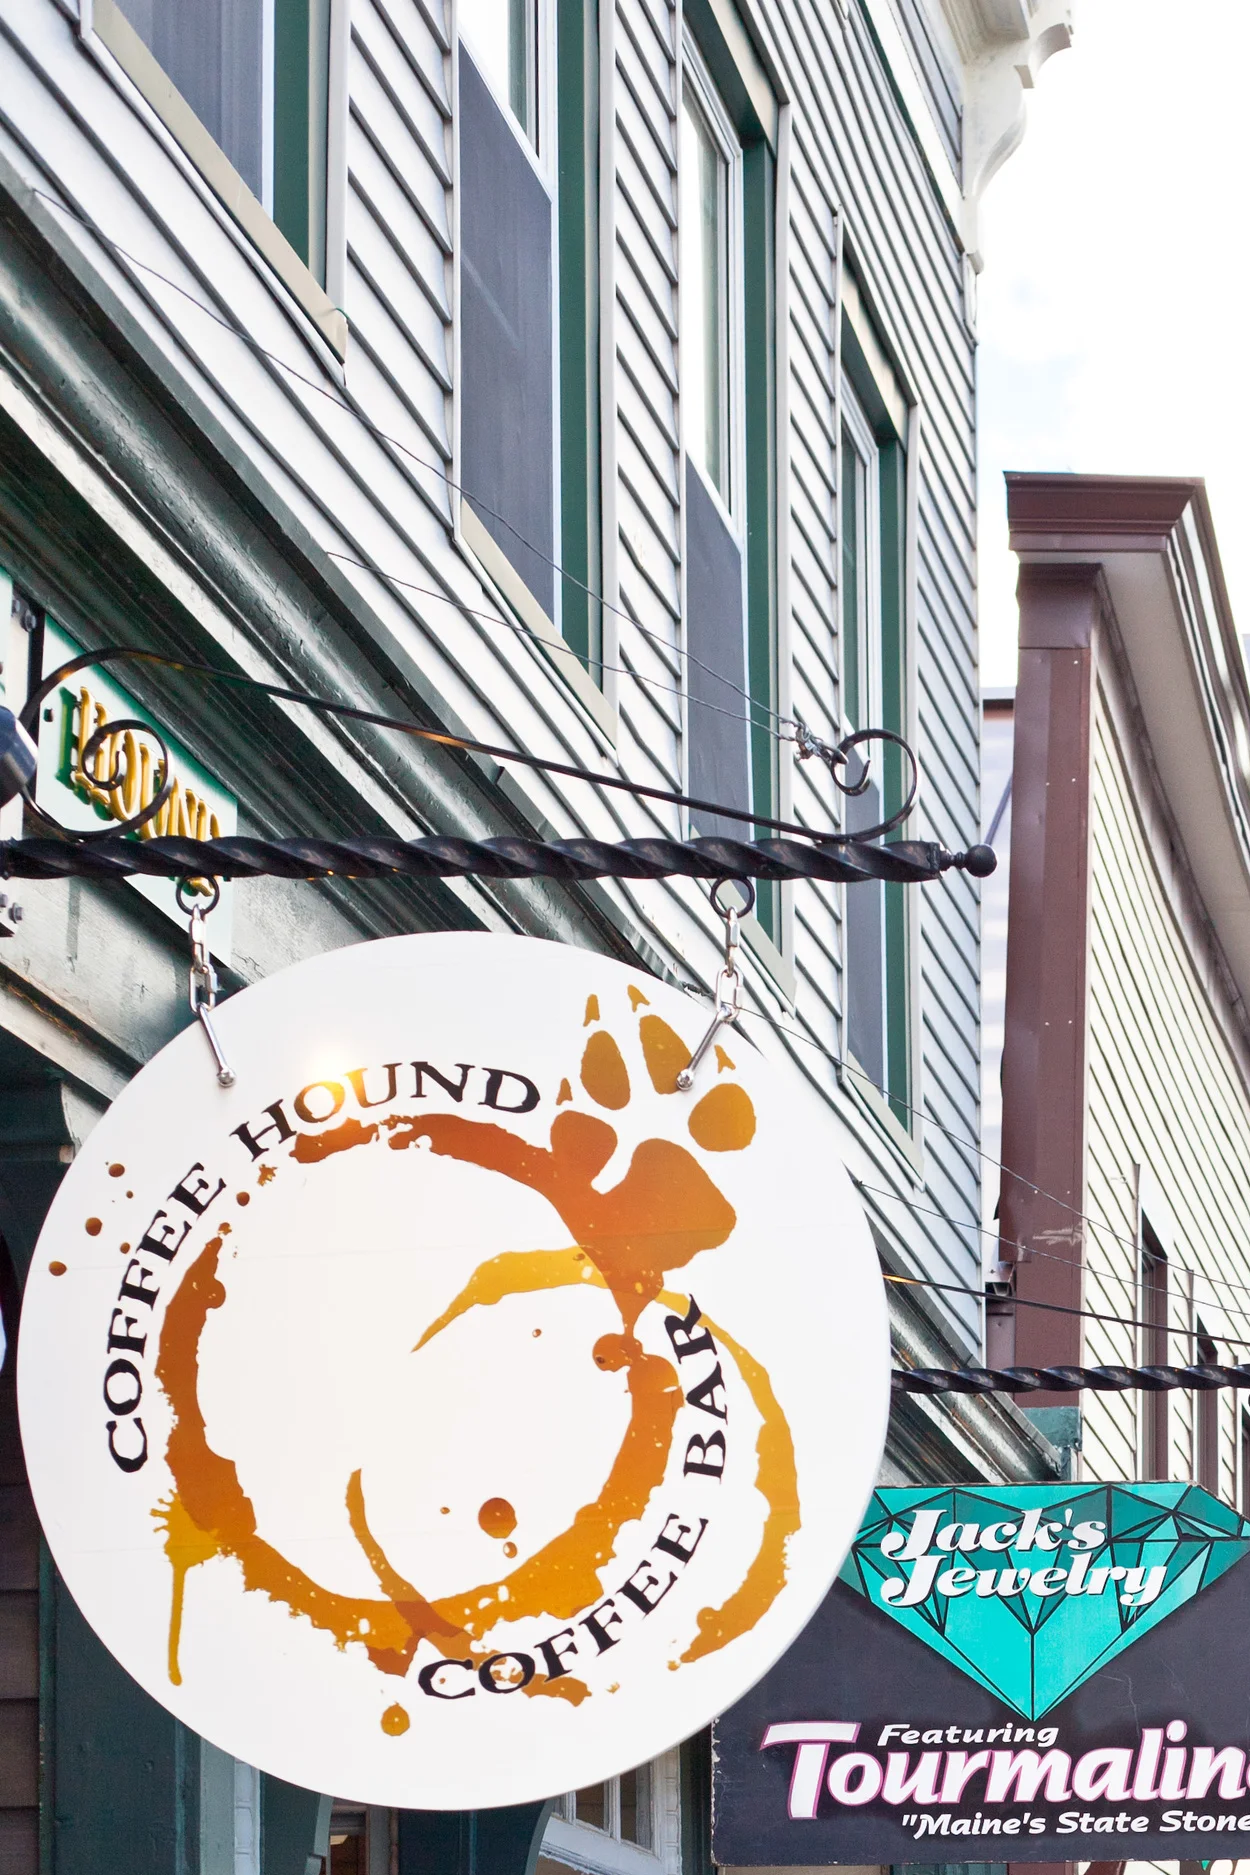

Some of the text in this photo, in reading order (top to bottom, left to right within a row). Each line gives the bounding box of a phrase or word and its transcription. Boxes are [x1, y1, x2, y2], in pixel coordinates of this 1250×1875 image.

[103, 1062, 540, 1474] COFFEE HOUND
[418, 1295, 729, 1700] COFFEE BAR
[880, 1508, 1106, 1561] Jack's
[880, 1545, 1167, 1608] Jewelry
[878, 1724, 1059, 1748] Featuring
[902, 1813, 1046, 1840] "Maine's
[1056, 1811, 1148, 1833] State
